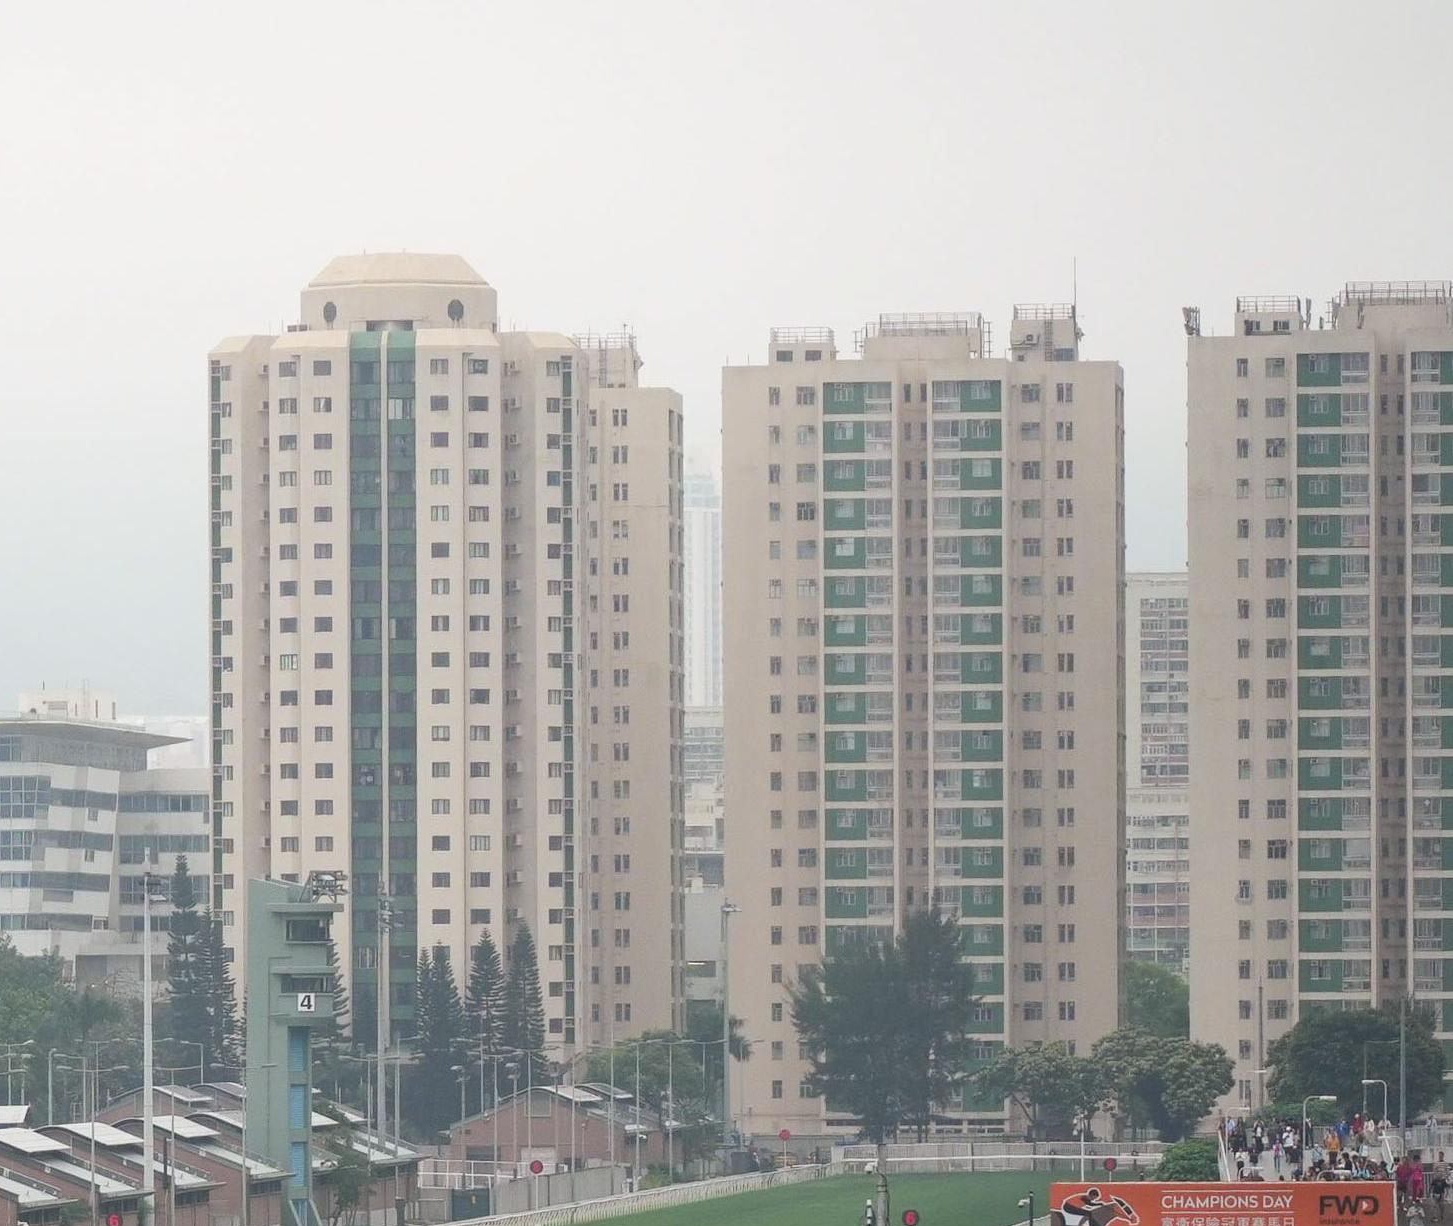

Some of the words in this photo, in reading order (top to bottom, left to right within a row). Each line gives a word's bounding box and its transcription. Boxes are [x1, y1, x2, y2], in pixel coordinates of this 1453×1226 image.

[300, 995, 312, 1010] 4
[1161, 1195, 1259, 1209] CHAMPIONS
[1262, 1195, 1294, 1209] DAY
[1319, 1195, 1379, 1216] FWD
